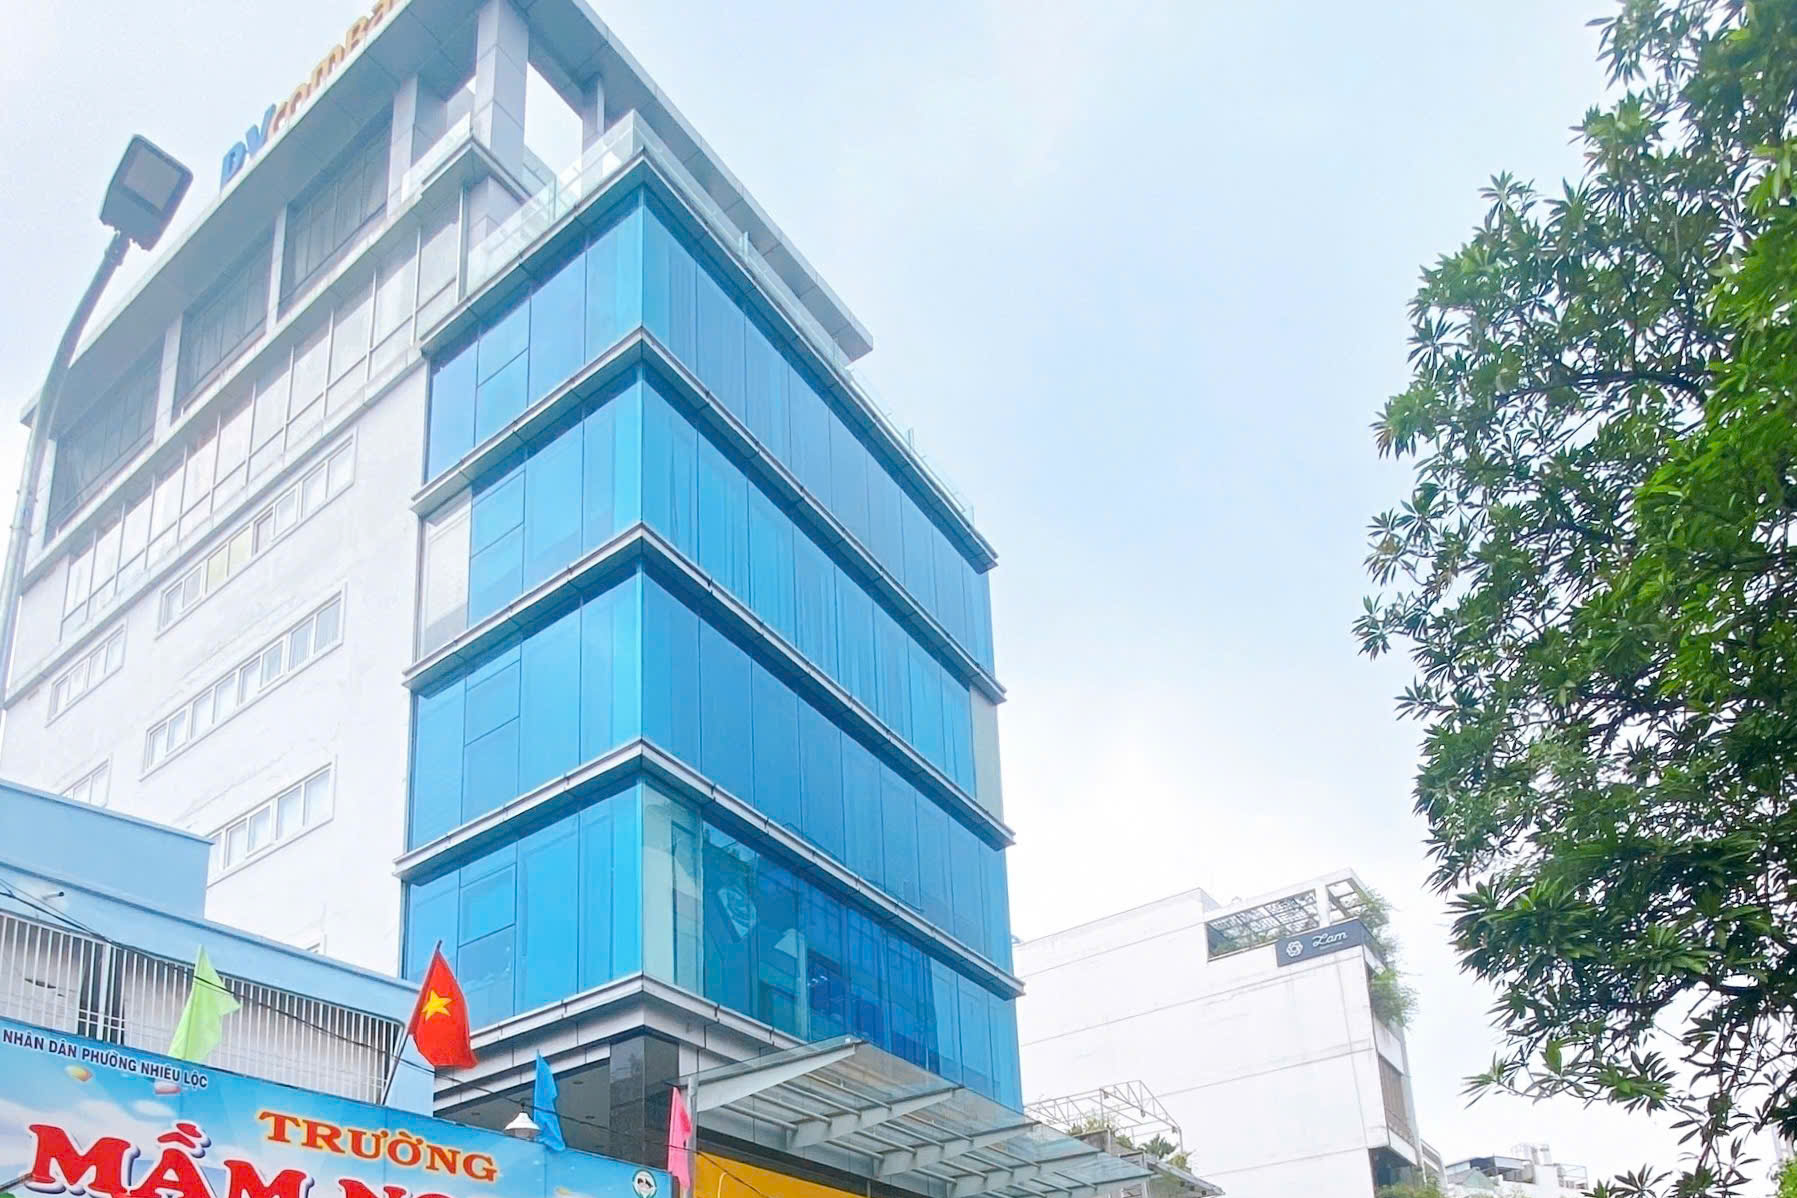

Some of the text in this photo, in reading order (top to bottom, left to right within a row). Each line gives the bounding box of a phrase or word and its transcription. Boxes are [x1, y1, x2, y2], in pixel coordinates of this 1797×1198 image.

[3, 1029, 44, 1051] NHÂN
[49, 1037, 77, 1059] DÂN
[184, 1070, 208, 1090] LỘC
[259, 1110, 498, 1182] TRƯỜNG
